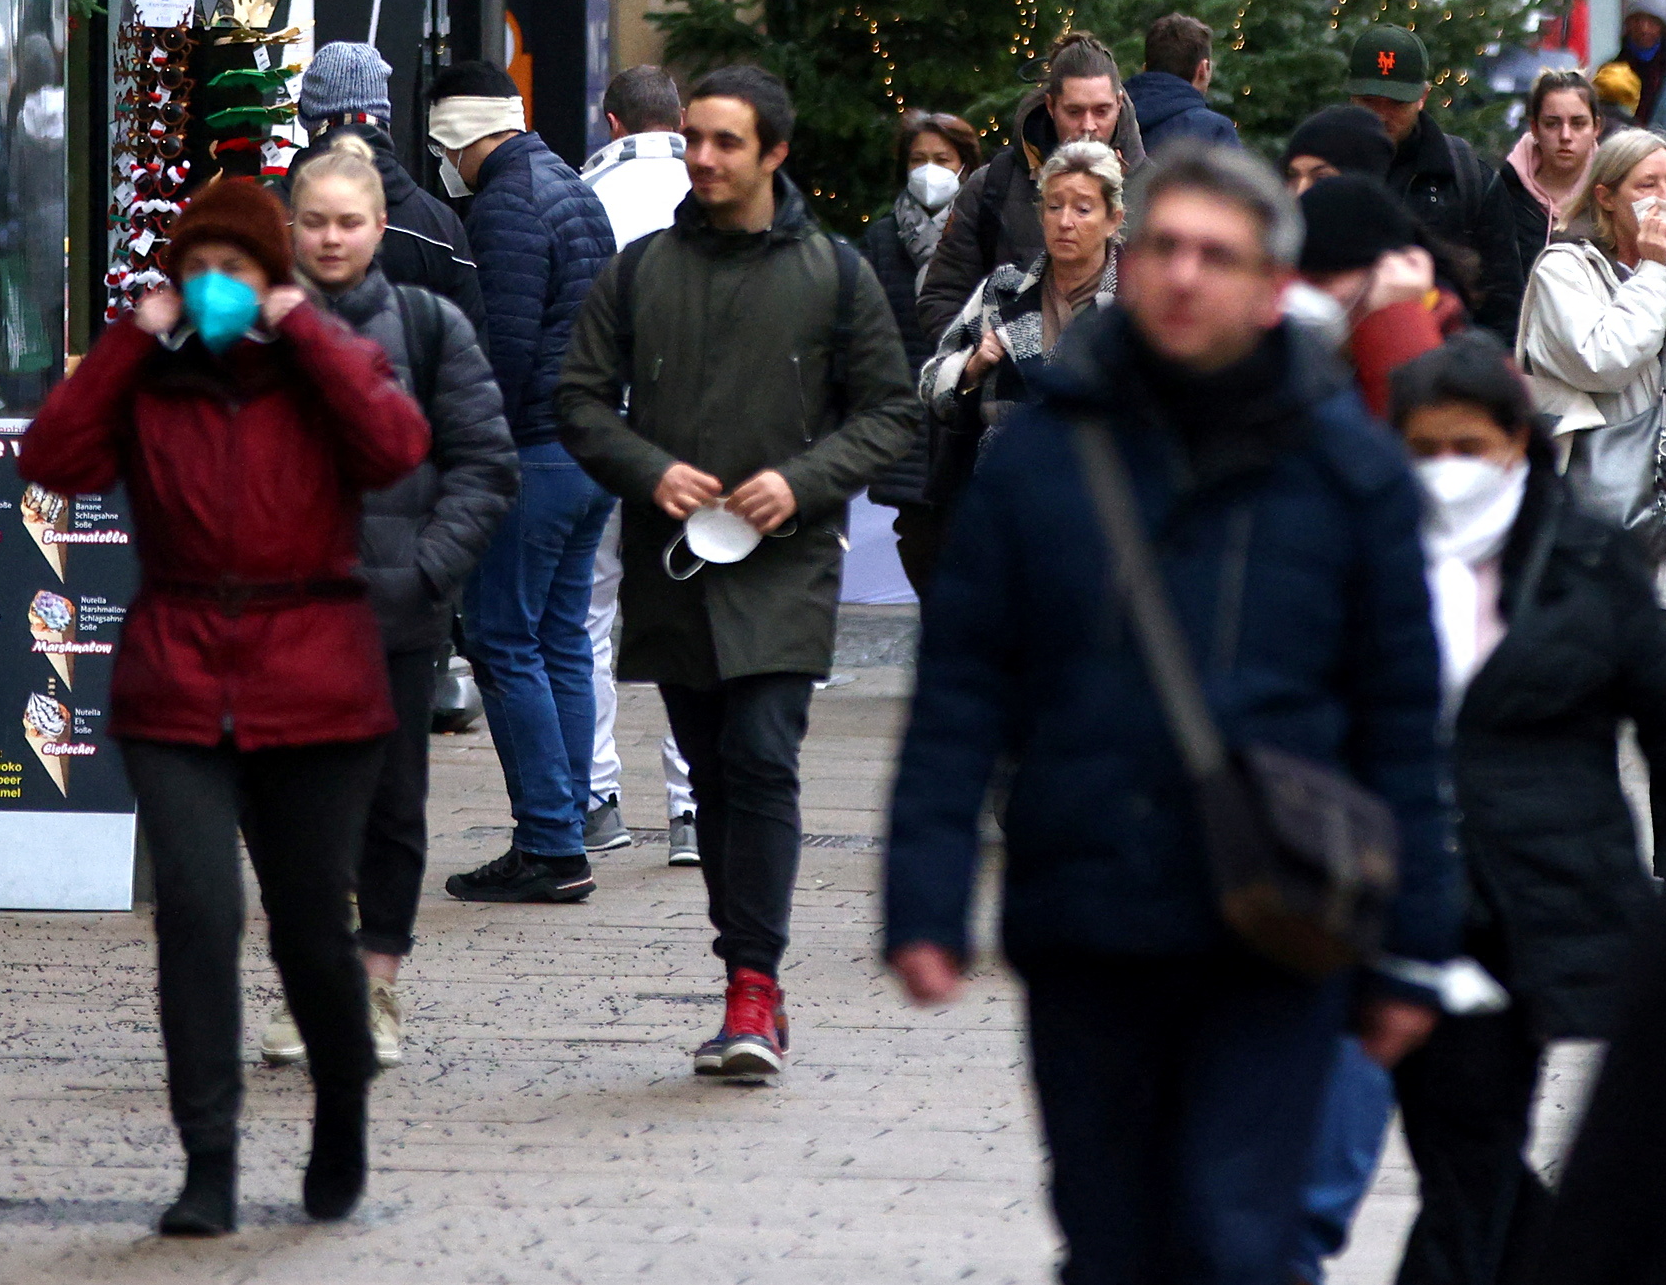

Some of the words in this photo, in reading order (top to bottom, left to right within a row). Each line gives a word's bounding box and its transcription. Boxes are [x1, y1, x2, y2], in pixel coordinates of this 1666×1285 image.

[75, 503, 102, 511] Banane
[75, 512, 119, 521] Schlagsahne
[75, 521, 93, 529] Soße
[43, 529, 129, 545] Bananatella
[81, 596, 107, 604] Nutella
[80, 614, 124, 623] Schlagsahne
[79, 623, 97, 631] Soße
[32, 639, 112, 655] Marshmalow
[75, 708, 101, 717] Nutella
[74, 726, 92, 734] Soße
[41, 741, 97, 756] Eisbecher
